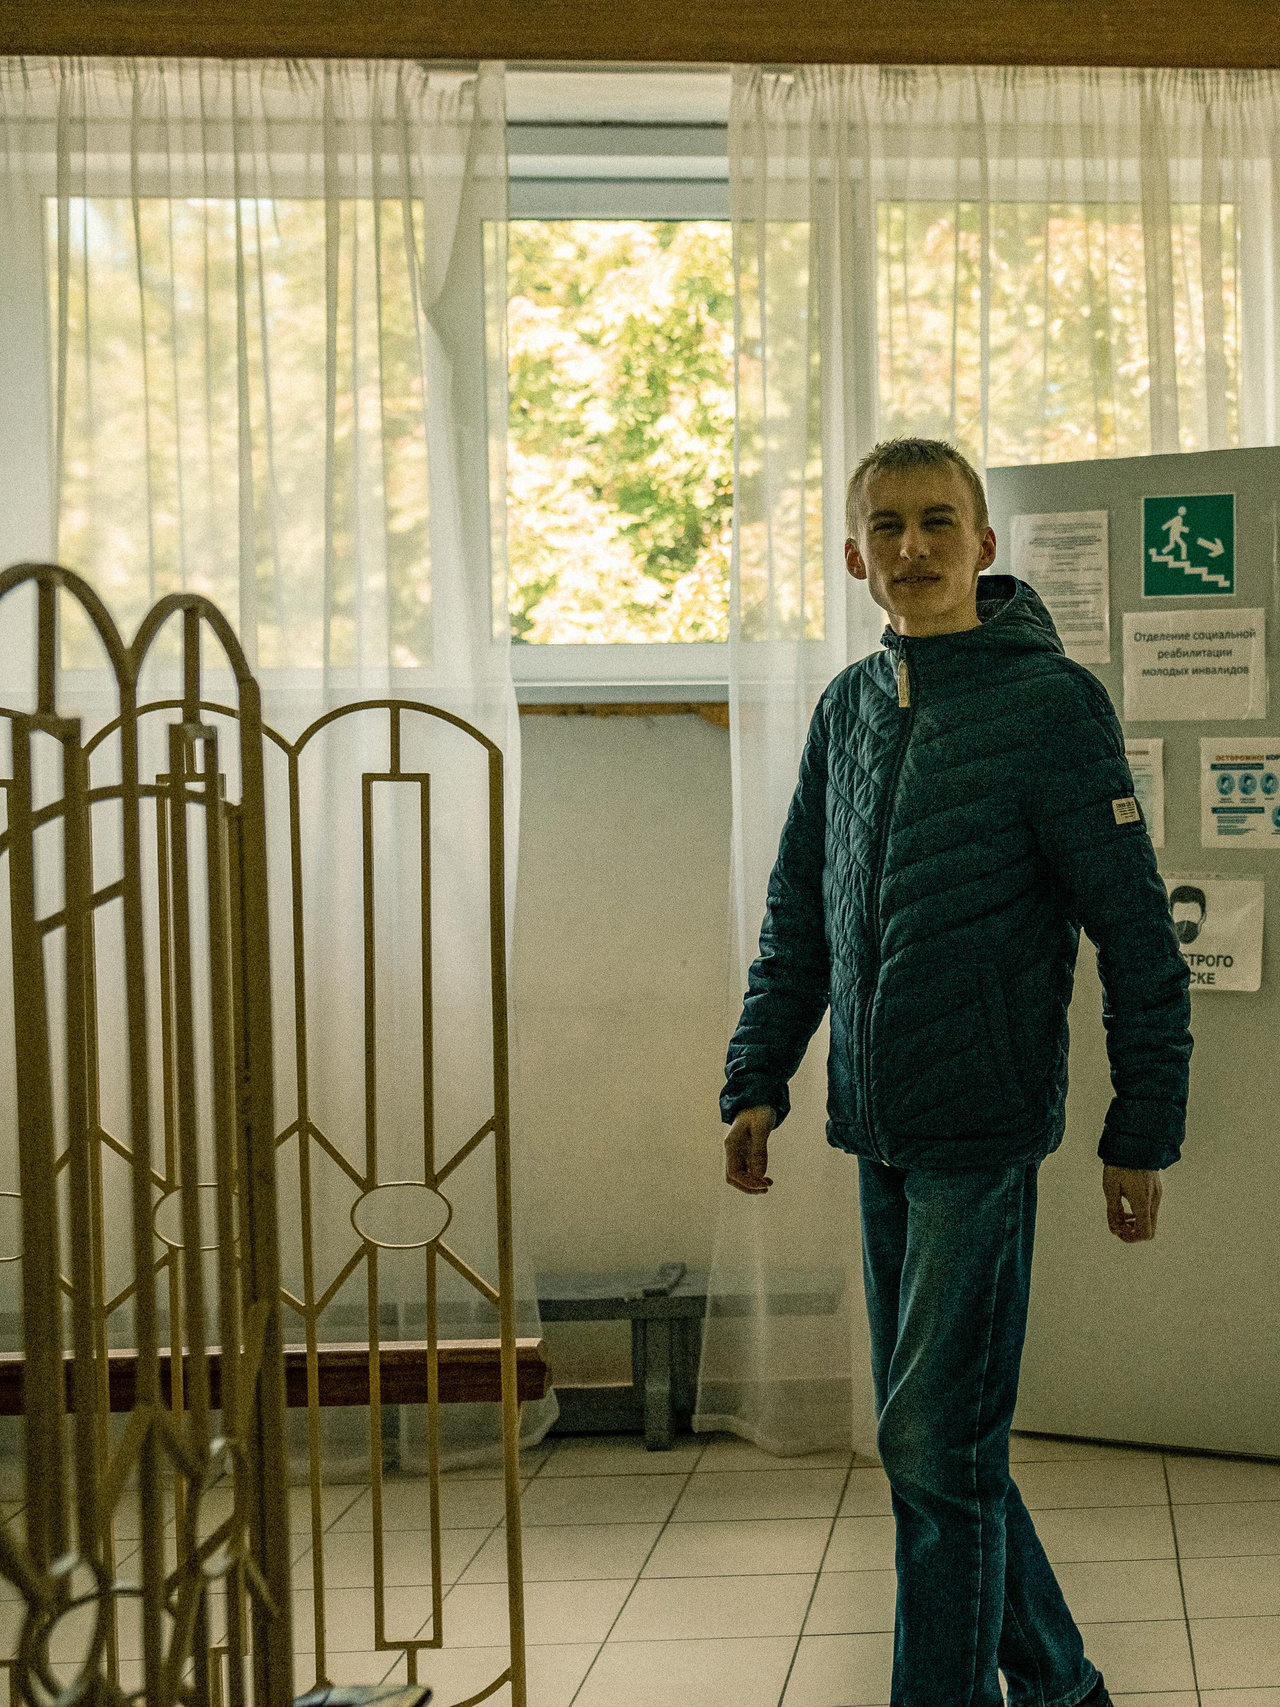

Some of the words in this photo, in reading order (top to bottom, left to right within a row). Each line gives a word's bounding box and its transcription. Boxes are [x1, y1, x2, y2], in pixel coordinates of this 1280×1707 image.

[1134, 631, 1191, 643] Отделение
[1193, 628, 1256, 641] социальной
[1157, 648, 1233, 660] реабилитации
[1142, 667, 1189, 677] молодых
[1192, 665, 1249, 676] инвалидов
[1189, 972, 1216, 985] СКЕ
